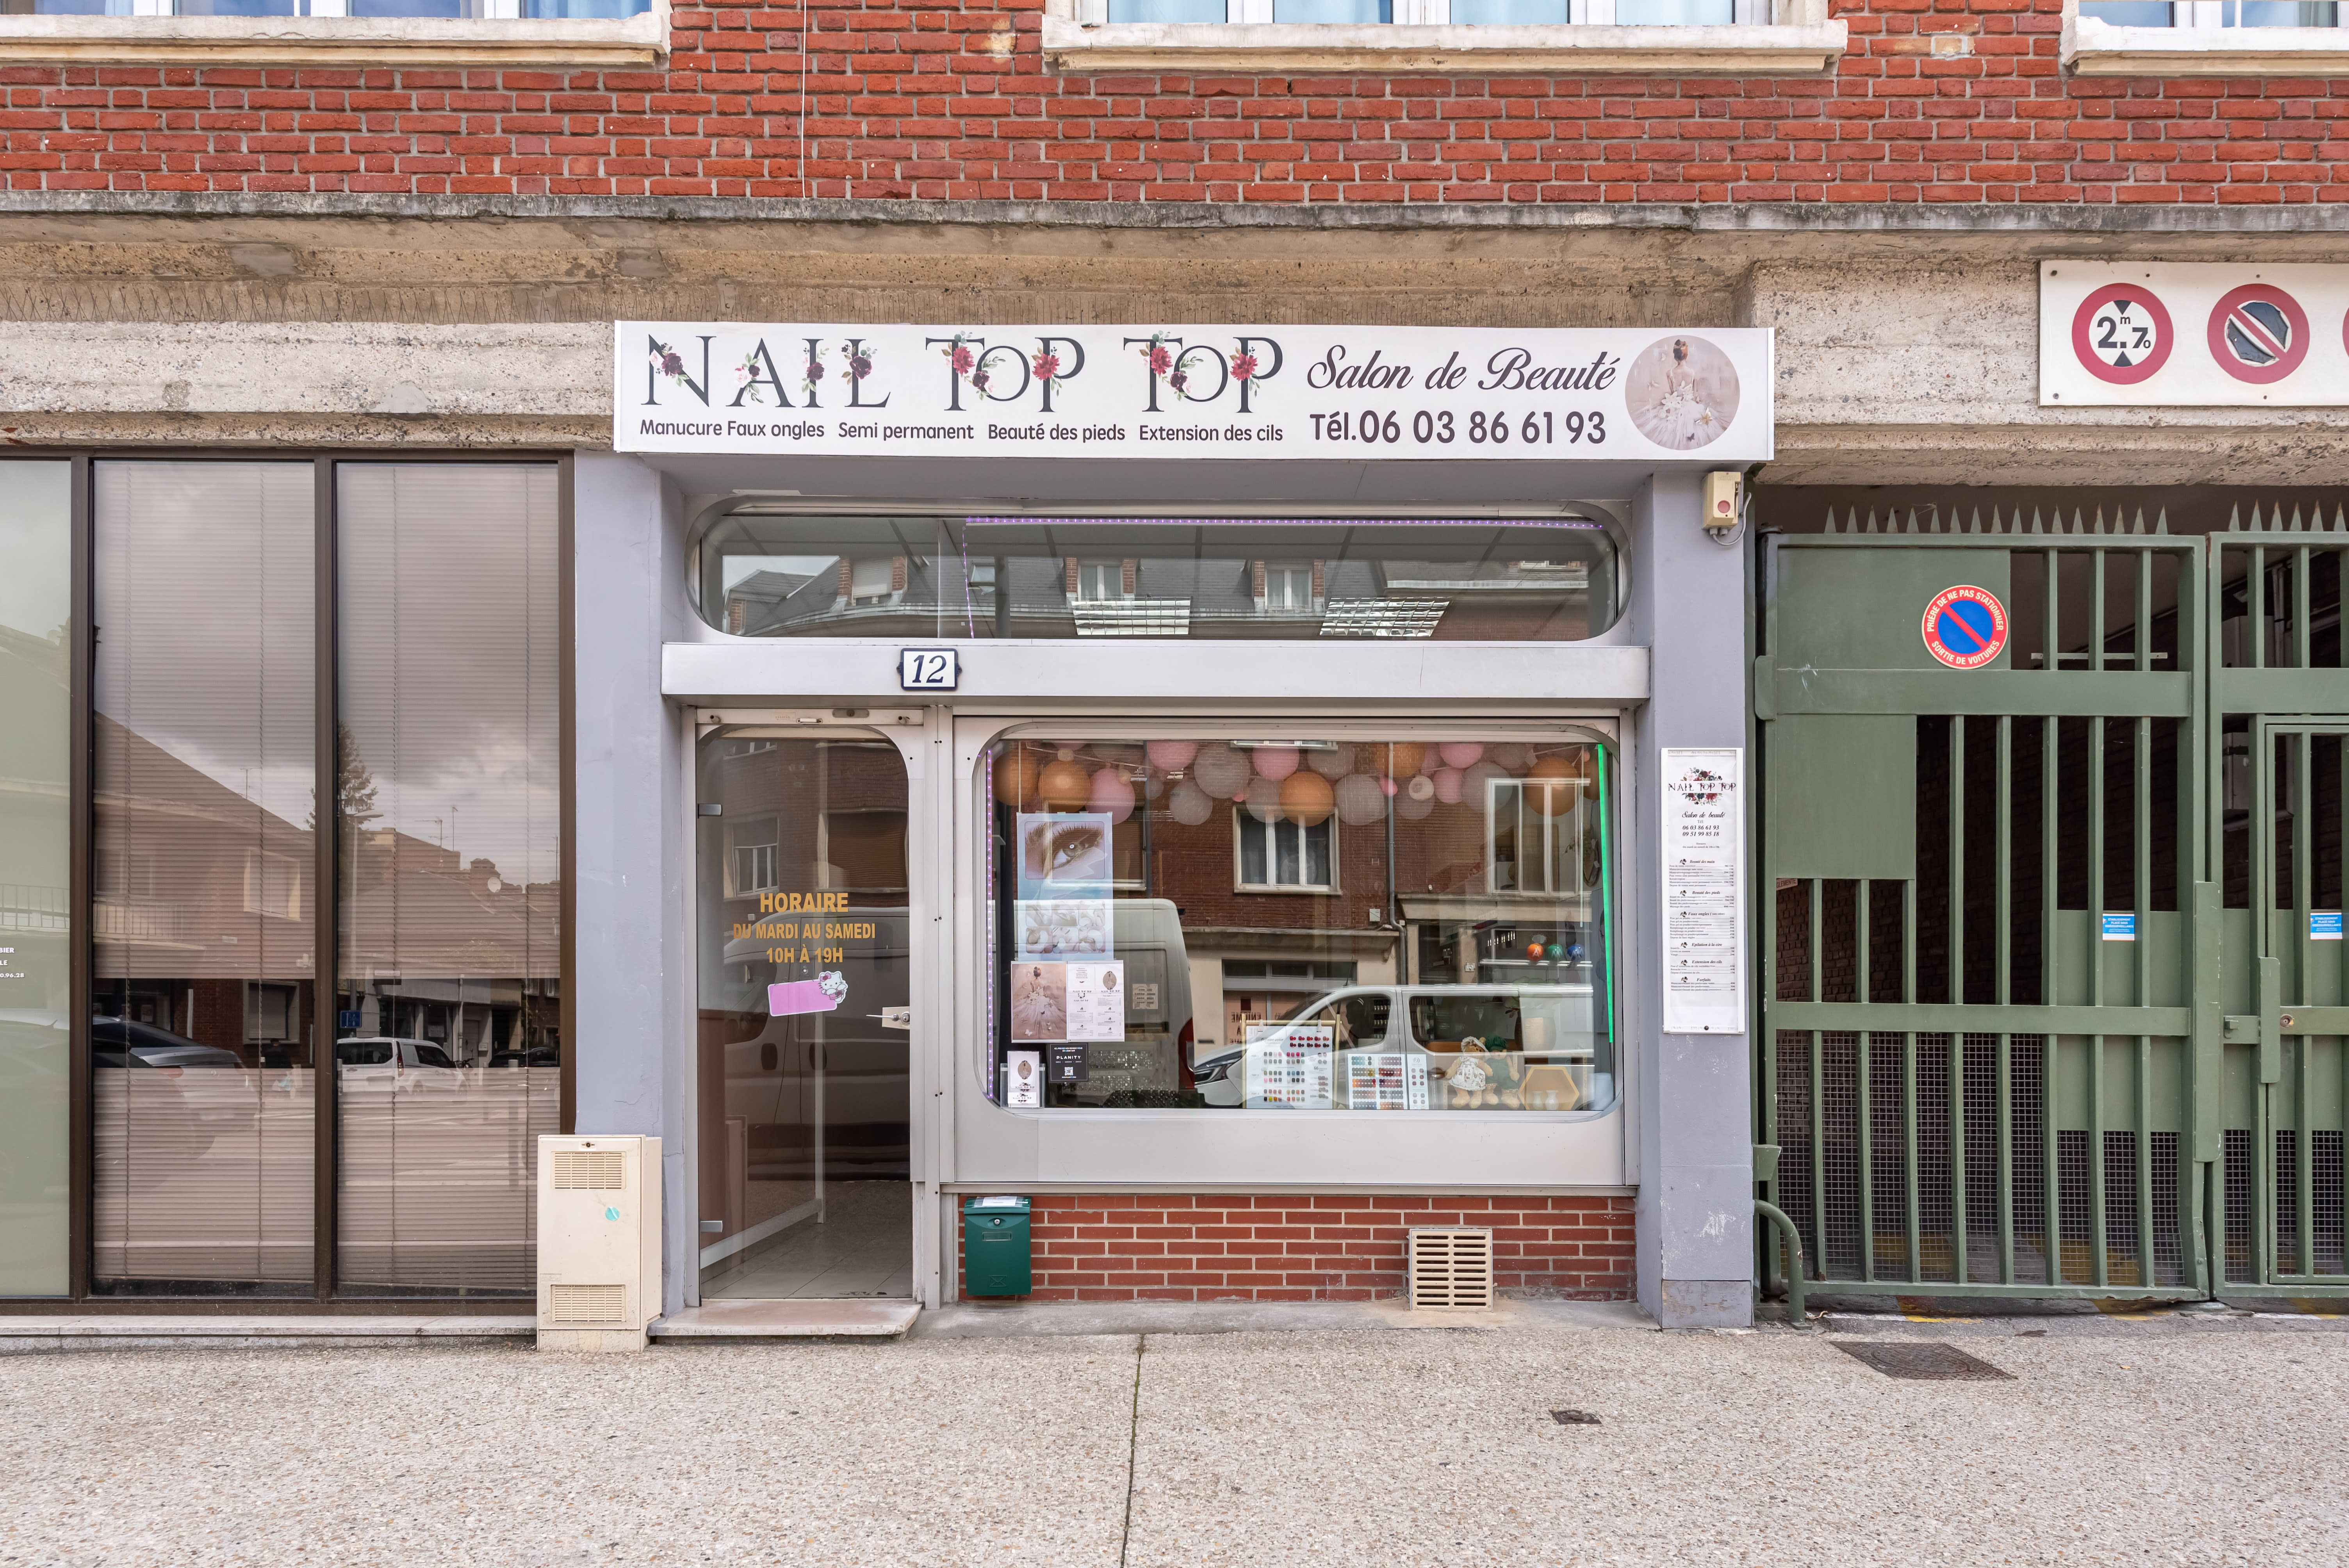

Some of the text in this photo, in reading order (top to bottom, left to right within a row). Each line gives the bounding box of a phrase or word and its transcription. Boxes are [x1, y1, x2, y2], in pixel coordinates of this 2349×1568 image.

[641, 334, 1283, 413] NAIL TOP TOP
[1307, 345, 1616, 390] Salon de Beauté
[640, 419, 824, 440] Manucure Faux ongles
[839, 422, 974, 441] Semi permanent
[989, 423, 1125, 443] Beauté des pieds
[1140, 424, 1283, 441] Extension des cils
[1413, 410, 1455, 443] 03
[1469, 411, 1509, 444] 86
[1522, 411, 1552, 444] 61
[1566, 411, 1606, 444] 93
[1927, 590, 2004, 632] PRIÈRE DE NE PAS STATIONNER
[1932, 640, 2000, 665] SORTIE DE VOITURES
[912, 655, 946, 683] 12
[1668, 782, 1736, 791] NAIL TOP TOP
[760, 893, 849, 912] HORAIRE
[733, 923, 875, 939] DU MARDI AU SAMEDI
[766, 944, 843, 963] 10H À 19H
